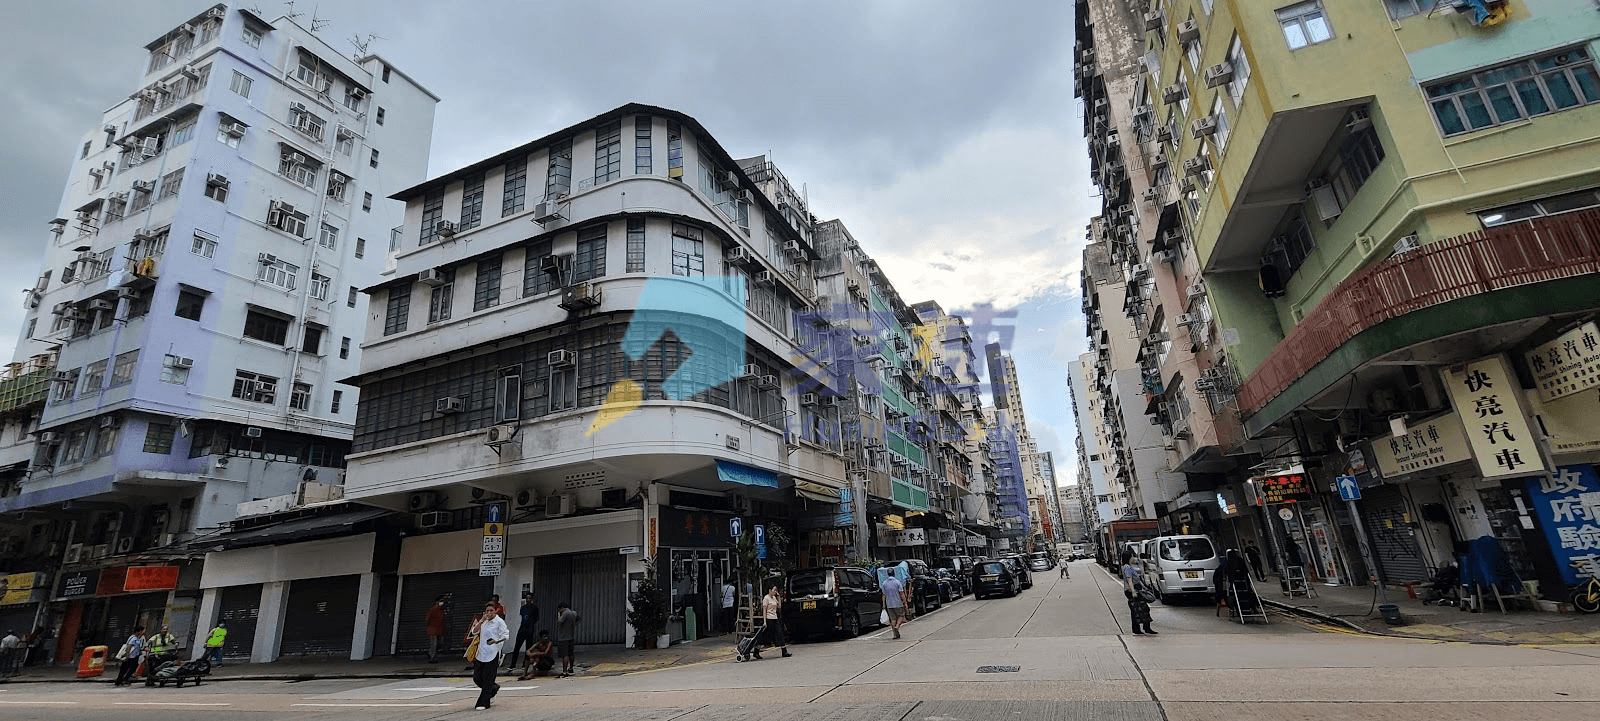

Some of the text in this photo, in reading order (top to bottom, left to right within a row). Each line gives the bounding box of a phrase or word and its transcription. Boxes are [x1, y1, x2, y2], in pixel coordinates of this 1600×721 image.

[1532, 332, 1598, 373] 快亮汽車
[1559, 361, 1582, 373] Shining
[1464, 369, 1525, 470] 快亮汽車
[1389, 424, 1440, 456] 快亮汽車
[756, 527, 763, 543] P
[1539, 469, 1600, 579] 政府驗車
[66, 574, 87, 585] POWER
